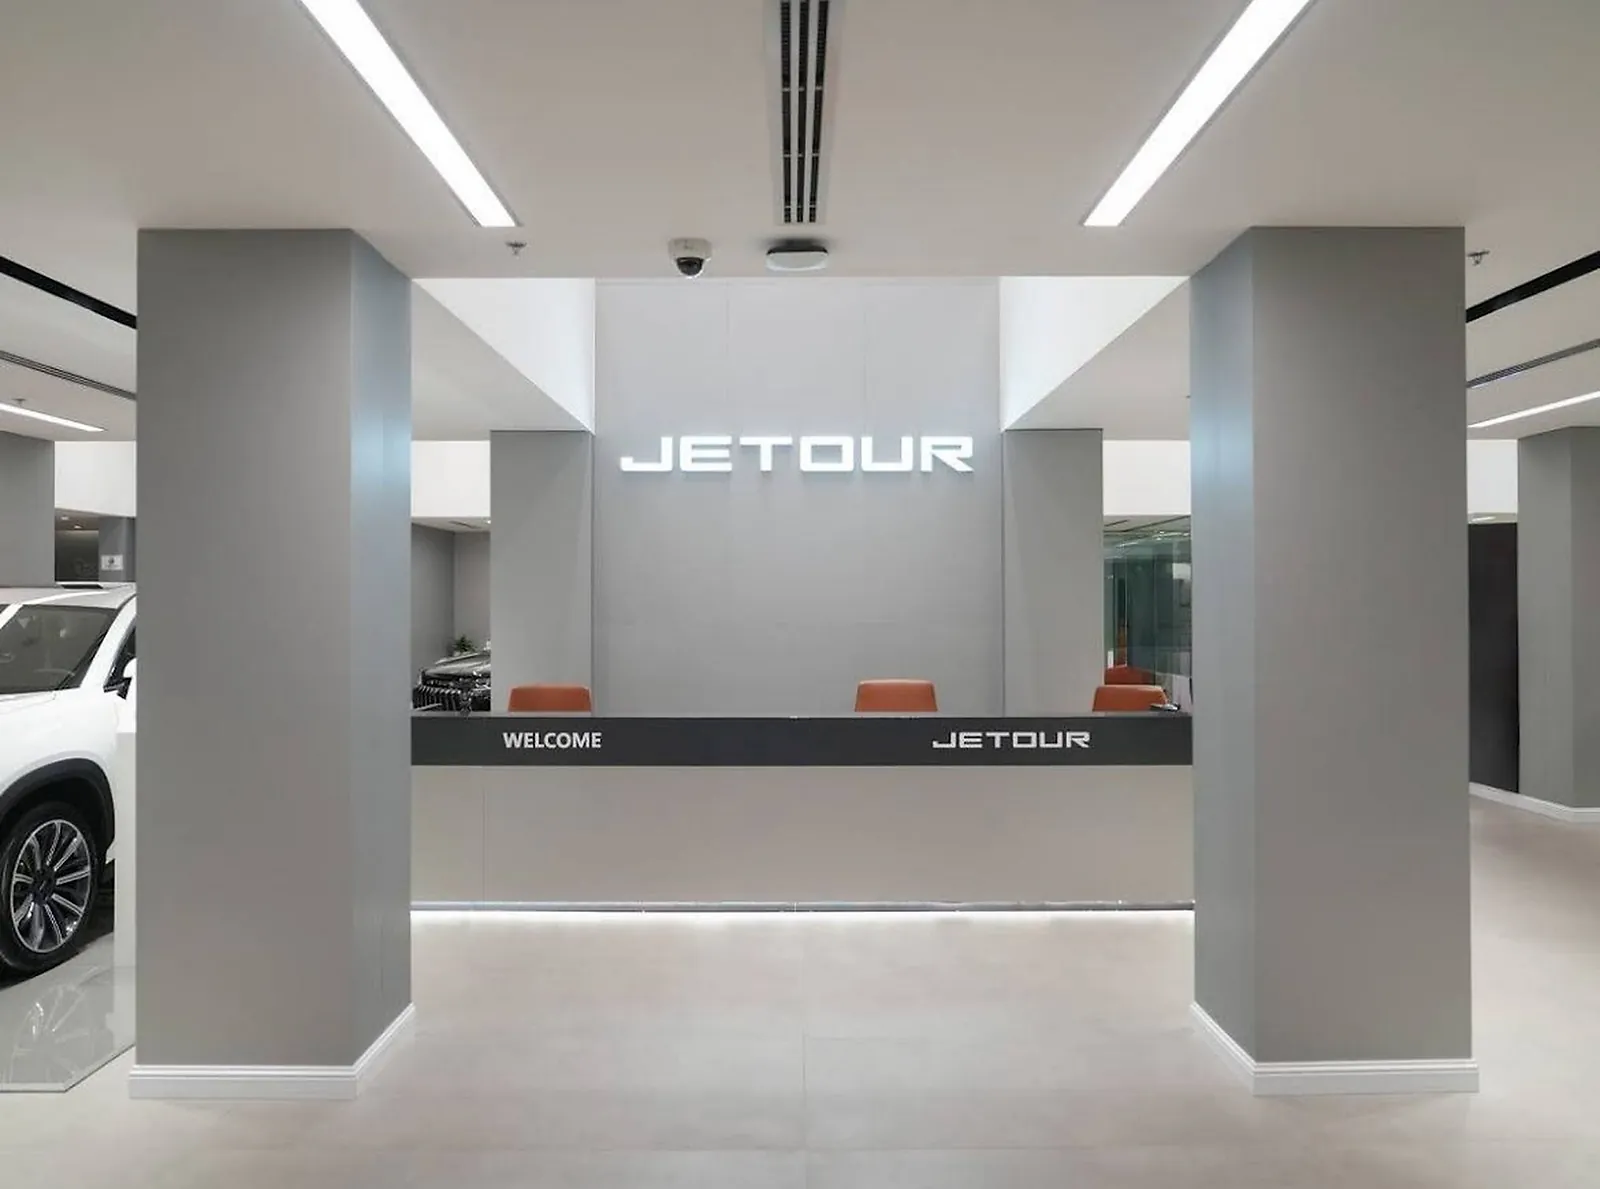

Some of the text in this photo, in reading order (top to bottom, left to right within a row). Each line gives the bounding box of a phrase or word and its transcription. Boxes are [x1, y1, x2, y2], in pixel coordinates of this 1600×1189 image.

[620, 435, 974, 473] JETOUR
[502, 732, 602, 749] WELCOME
[932, 731, 1091, 749] JETOUR
